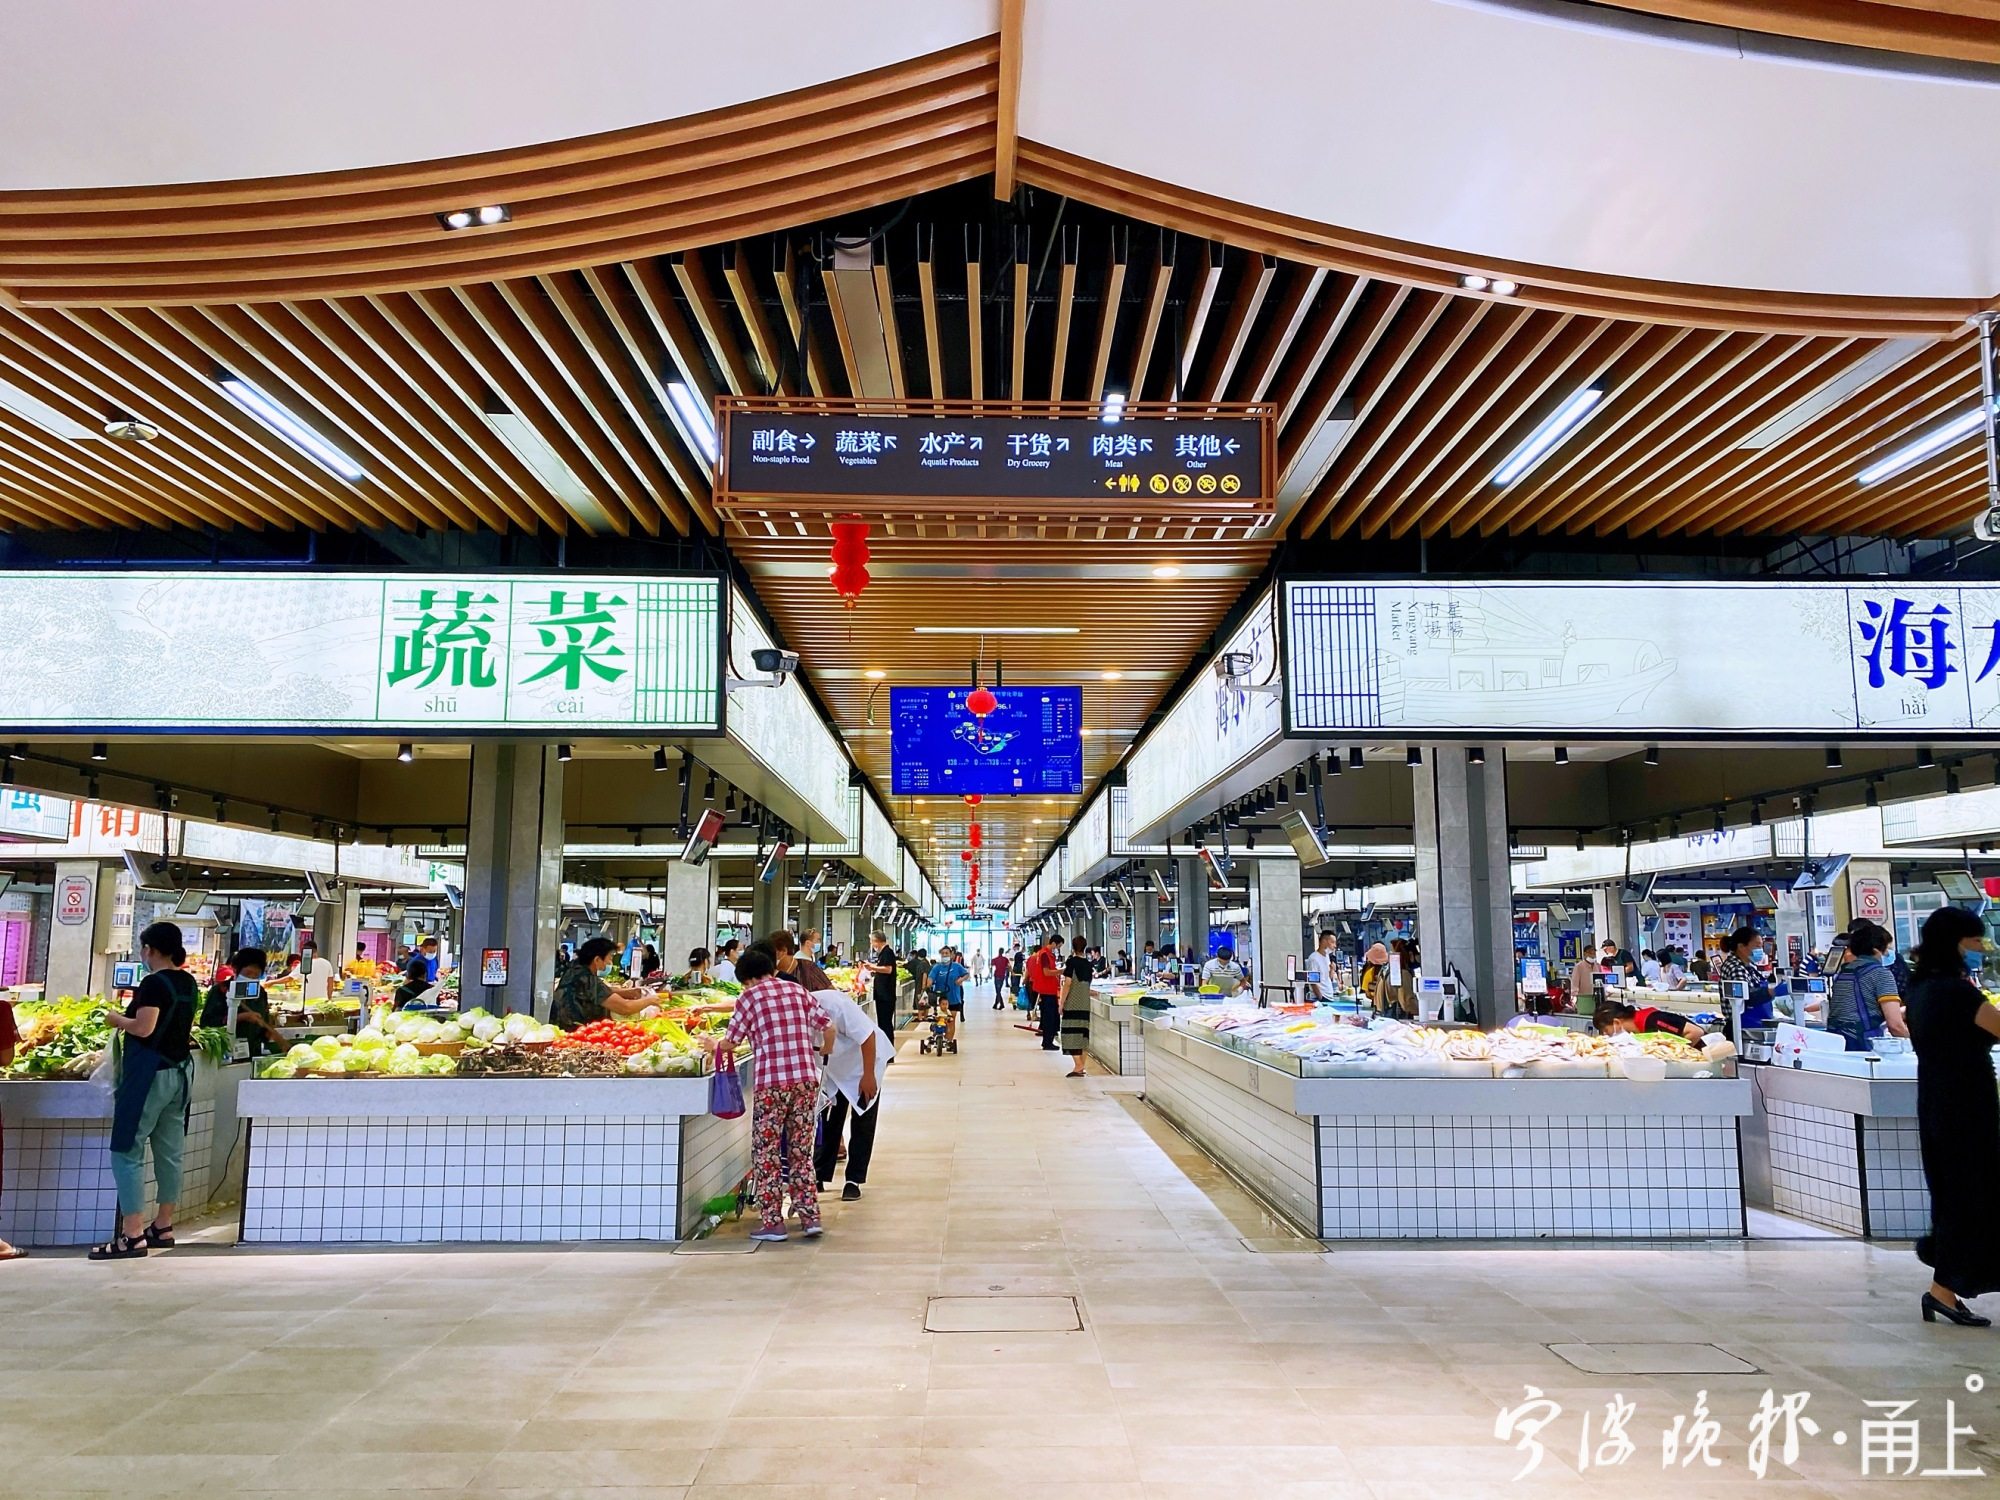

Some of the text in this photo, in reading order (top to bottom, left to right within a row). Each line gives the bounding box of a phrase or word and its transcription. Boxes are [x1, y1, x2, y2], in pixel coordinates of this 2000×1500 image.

[752, 429, 798, 452] 副食
[835, 430, 882, 453] 蔬菜
[919, 431, 965, 455] 水产
[1006, 433, 1052, 456] 干货
[1093, 433, 1137, 457] 肉类
[1175, 434, 1221, 457] 其他
[752, 455, 810, 464] Non-staple Food
[839, 456, 877, 465] Vegetables
[920, 457, 979, 467] Aquatic Products
[1007, 459, 1051, 468] Dry Grocery
[1105, 459, 1123, 468] Meat
[1186, 460, 1208, 468] Other
[1391, 601, 1402, 641] Market
[386, 589, 629, 690] 蔬菜
[424, 695, 458, 713] shū
[556, 696, 585, 714] cài
[1900, 696, 1927, 715] hǎi
